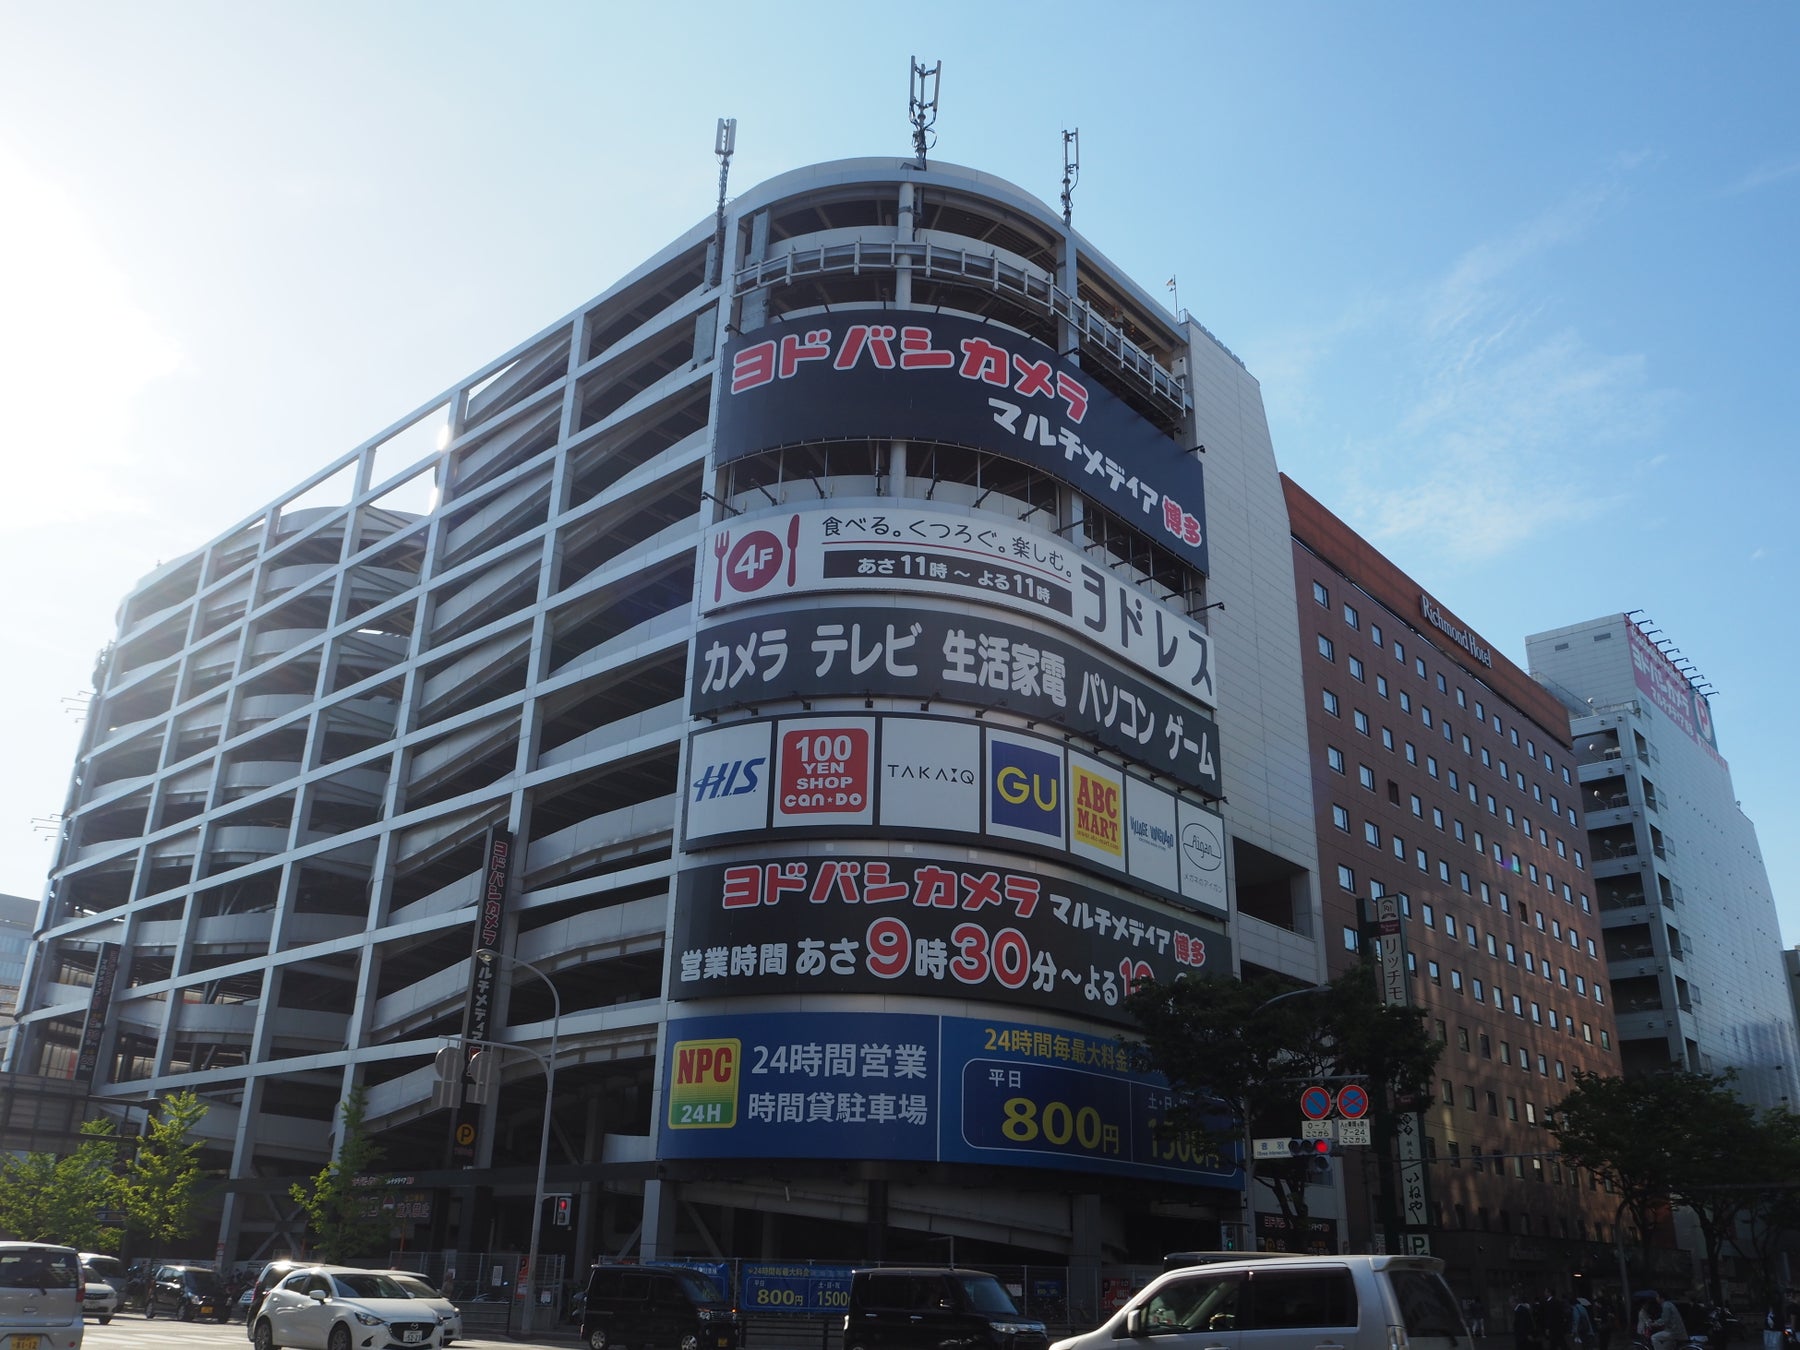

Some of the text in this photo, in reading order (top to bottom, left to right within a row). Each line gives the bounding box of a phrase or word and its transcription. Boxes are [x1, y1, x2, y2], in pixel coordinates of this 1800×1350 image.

[731, 325, 1089, 423] ヨドバシカメラ
[988, 398, 1202, 547] マルチメディア 博多
[734, 547, 773, 580] 4F
[1081, 564, 1213, 696] ヨドレス
[1421, 594, 1492, 669] Richmond Hotel
[701, 622, 1216, 782] カメラ テレビ 生活家電 パソコン ゲーム
[795, 735, 852, 762] 100
[796, 777, 853, 790] SHOP
[803, 762, 844, 775] YEN
[997, 766, 1057, 812] GU
[1077, 774, 1117, 819] ABC
[1077, 808, 1118, 842] MART
[481, 840, 507, 946] ヨドバシカメラ
[722, 861, 1206, 967] ヨドバシカメラ マルチメディア 博多
[680, 943, 788, 982] 営業時間
[677, 1047, 732, 1084] NPC
[752, 1042, 928, 1079] 24時間営業
[988, 1068, 1022, 1089] 平日
[681, 1103, 721, 1123] 24H
[748, 1092, 928, 1126] 時間貸駐車場
[1002, 1097, 1120, 1155] 800円
[1412, 1236, 1425, 1255] P
[757, 1289, 803, 1306] 800円
[817, 1291, 851, 1306] 1500
